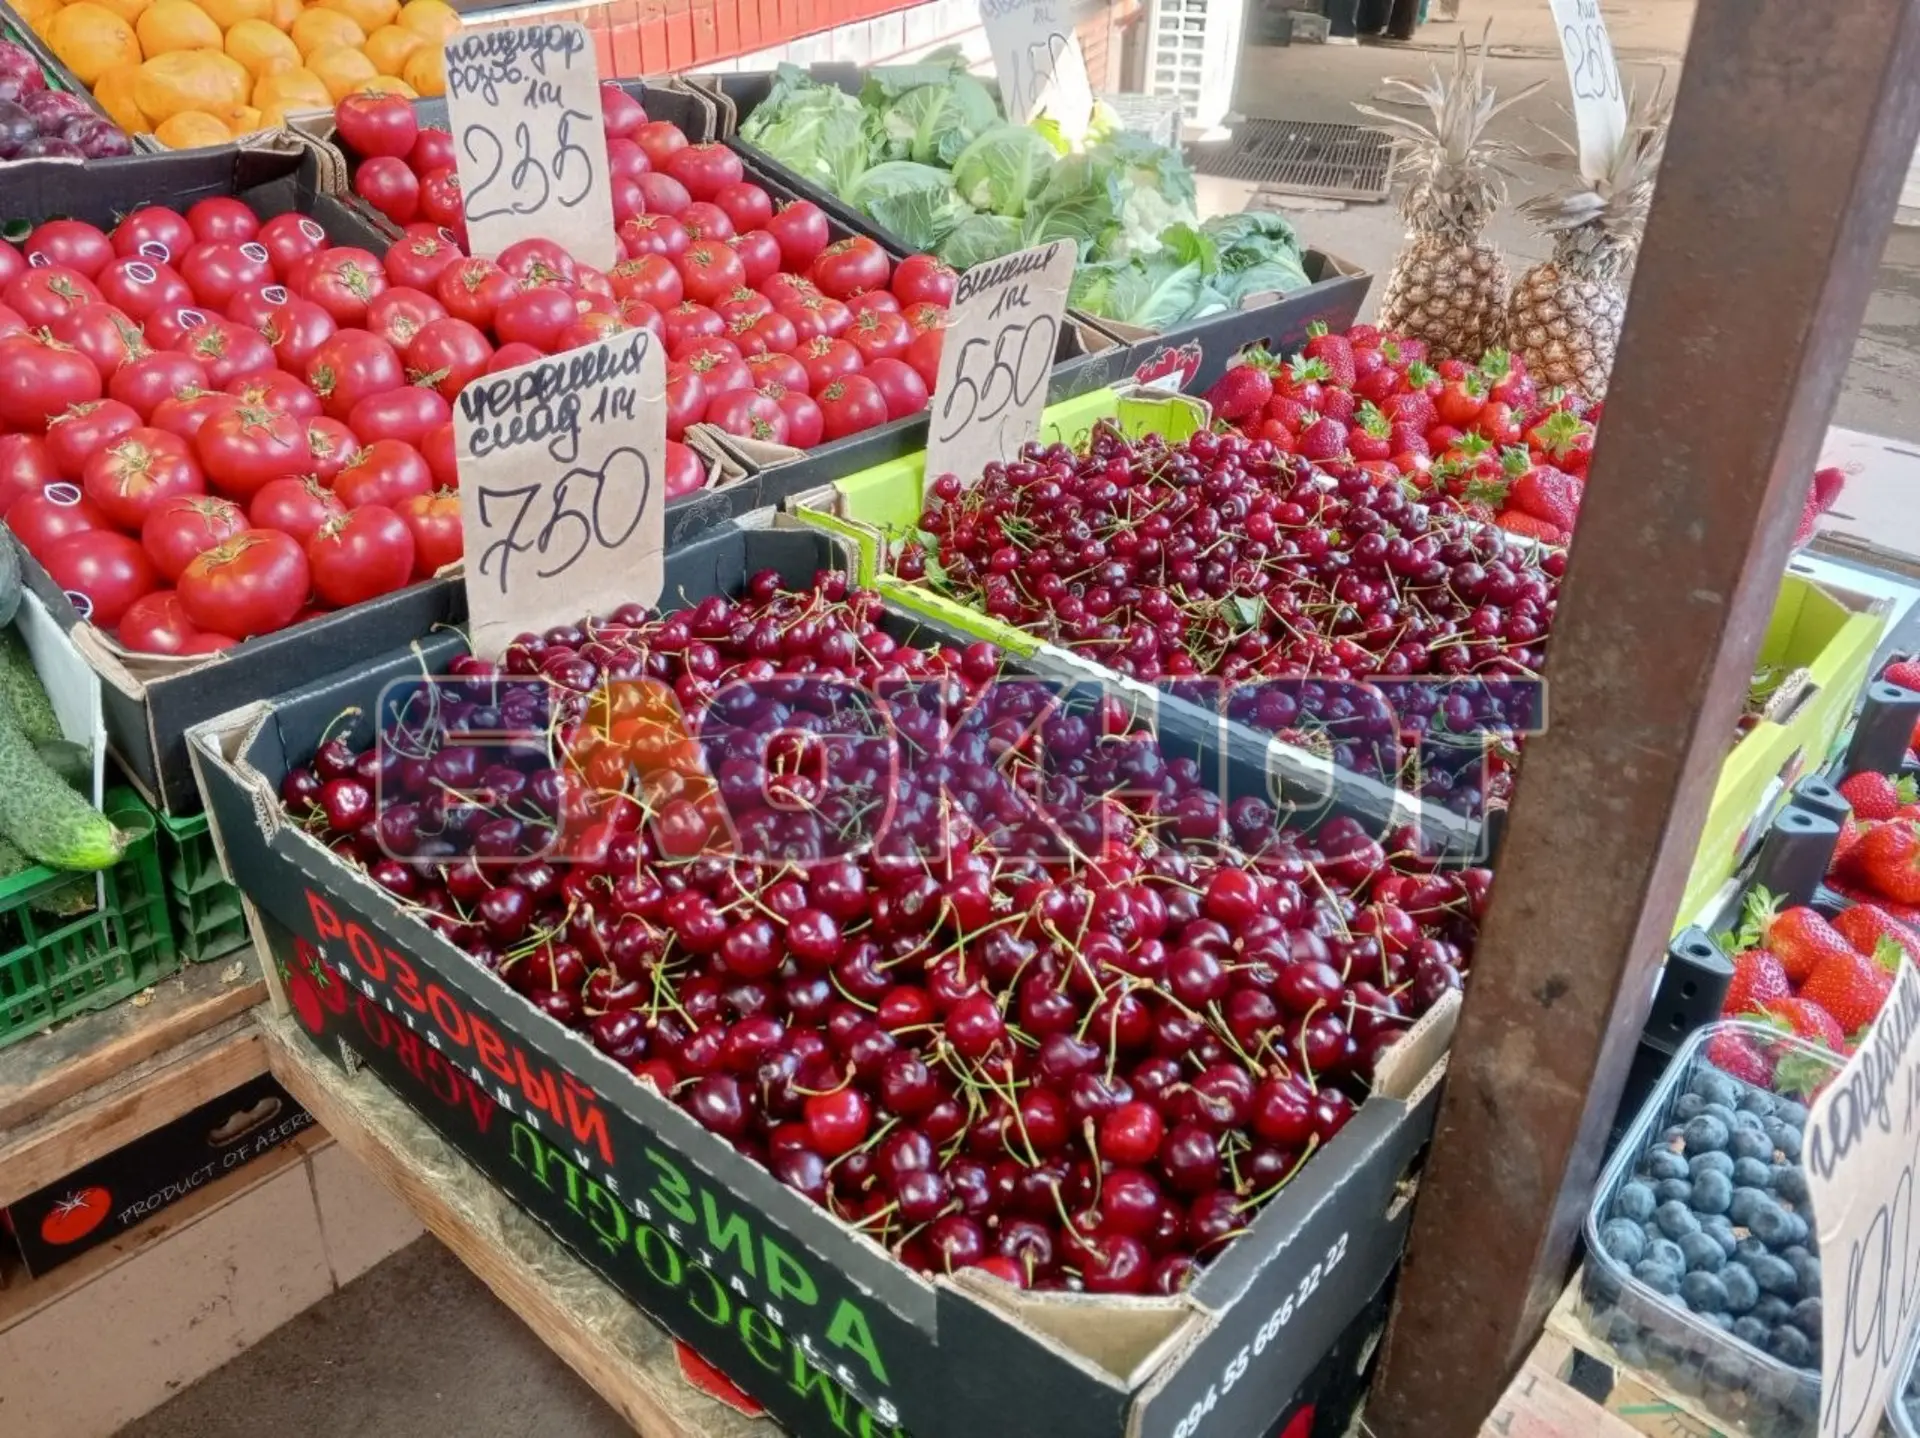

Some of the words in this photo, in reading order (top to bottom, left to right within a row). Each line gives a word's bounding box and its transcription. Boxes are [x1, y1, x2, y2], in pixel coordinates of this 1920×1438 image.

[463, 109, 593, 222] 235
[939, 314, 1056, 443] 550
[478, 446, 650, 594] 750
[117, 1162, 216, 1226] PRODUCT
[223, 1144, 250, 1168] OF
[305, 888, 615, 1166] РОЗОВЫЙ
[645, 1147, 891, 1387] ЗИРА
[573, 1148, 899, 1426] VEGETABLES
[1221, 1344, 1250, 1395] 55
[1253, 1294, 1295, 1357] 666
[1296, 1263, 1323, 1309] 22
[1324, 1231, 1350, 1277] 22
